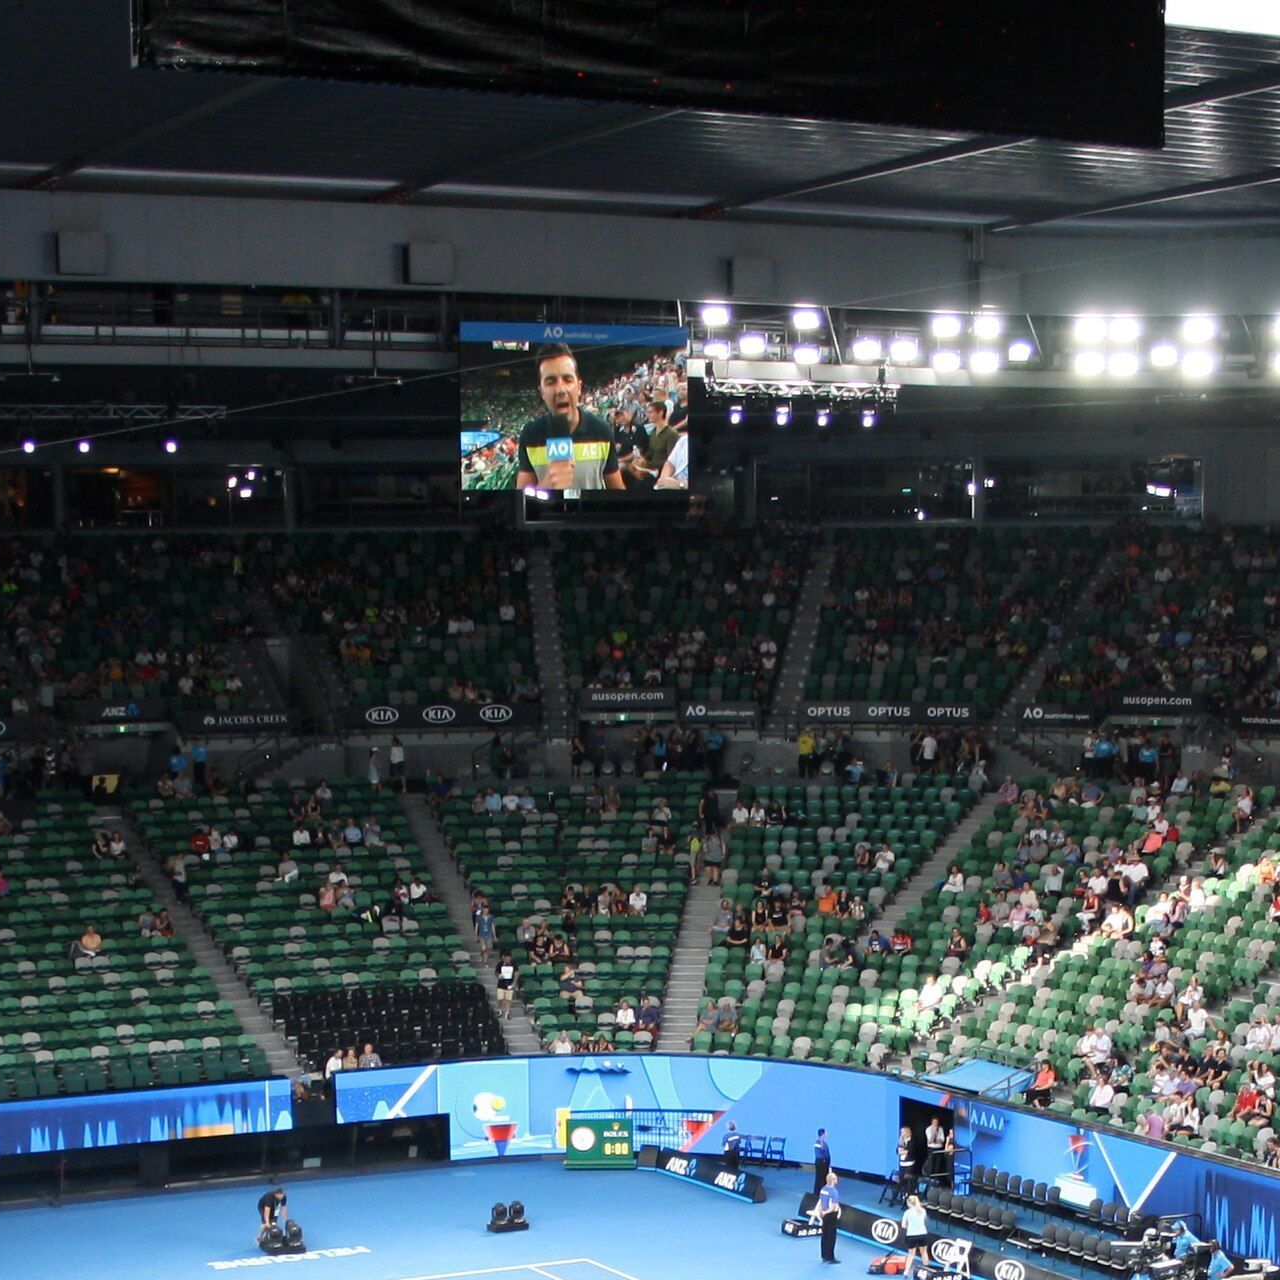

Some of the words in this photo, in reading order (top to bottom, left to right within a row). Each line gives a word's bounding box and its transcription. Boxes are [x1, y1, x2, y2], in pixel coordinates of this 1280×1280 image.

[543, 326, 564, 339] AO
[548, 441, 569, 457] AO
[591, 690, 664, 702] ausopen.com
[1122, 695, 1193, 707] ausopen.com
[371, 709, 395, 721] KIA
[427, 709, 451, 720] KIA
[484, 708, 508, 719] KIA
[685, 705, 706, 717] AO
[806, 706, 851, 718] OPTUS
[867, 706, 911, 718] OPTUS
[926, 706, 970, 718] OPTUS
[1023, 707, 1044, 720] AO
[256, 714, 289, 724] CREEK
[665, 1156, 689, 1175] ANZ
[714, 1171, 737, 1190] ANZ
[874, 1221, 895, 1241] KIA
